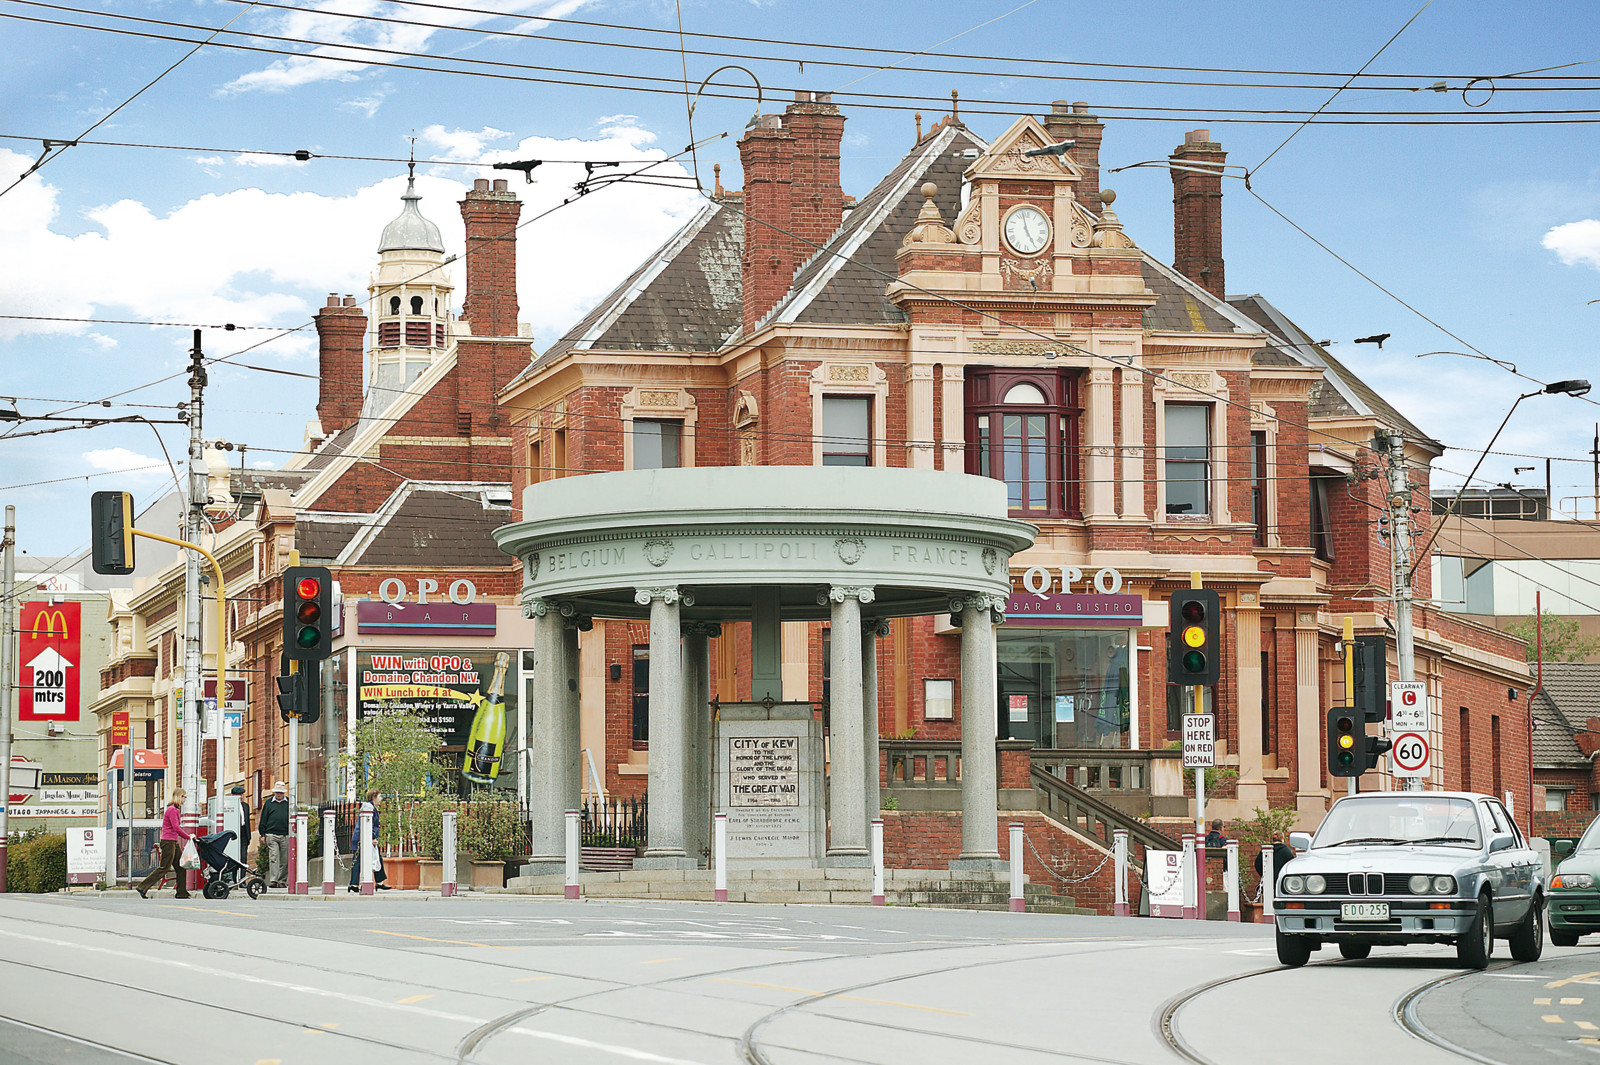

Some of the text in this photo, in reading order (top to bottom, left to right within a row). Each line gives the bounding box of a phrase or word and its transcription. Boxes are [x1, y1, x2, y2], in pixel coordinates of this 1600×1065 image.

[691, 542, 817, 561] GALLIPOLI
[892, 545, 968, 566] FRANCE
[550, 547, 626, 572] BELGIUM
[1023, 567, 1122, 600] QPO
[379, 578, 476, 609] QPO
[1014, 603, 1132, 612] BAR & BISTRO
[387, 612, 469, 621] BAR
[372, 655, 472, 671] WIN with QPO &
[36, 670, 64, 687] 200
[364, 671, 480, 684] Domaine Chandon N.V.
[35, 690, 64, 703] mtrs
[364, 687, 451, 697] WIN Lunch for 4 at
[1405, 692, 1414, 705] C
[1187, 717, 1210, 728] STOP
[1187, 731, 1211, 740] HERE
[734, 739, 760, 749] CITY
[772, 739, 794, 749] KEW
[1185, 743, 1213, 752] ON RED
[1400, 743, 1422, 760] 60
[1185, 755, 1213, 764] SIGNAL
[733, 785, 796, 793] THE GREAT WAR
